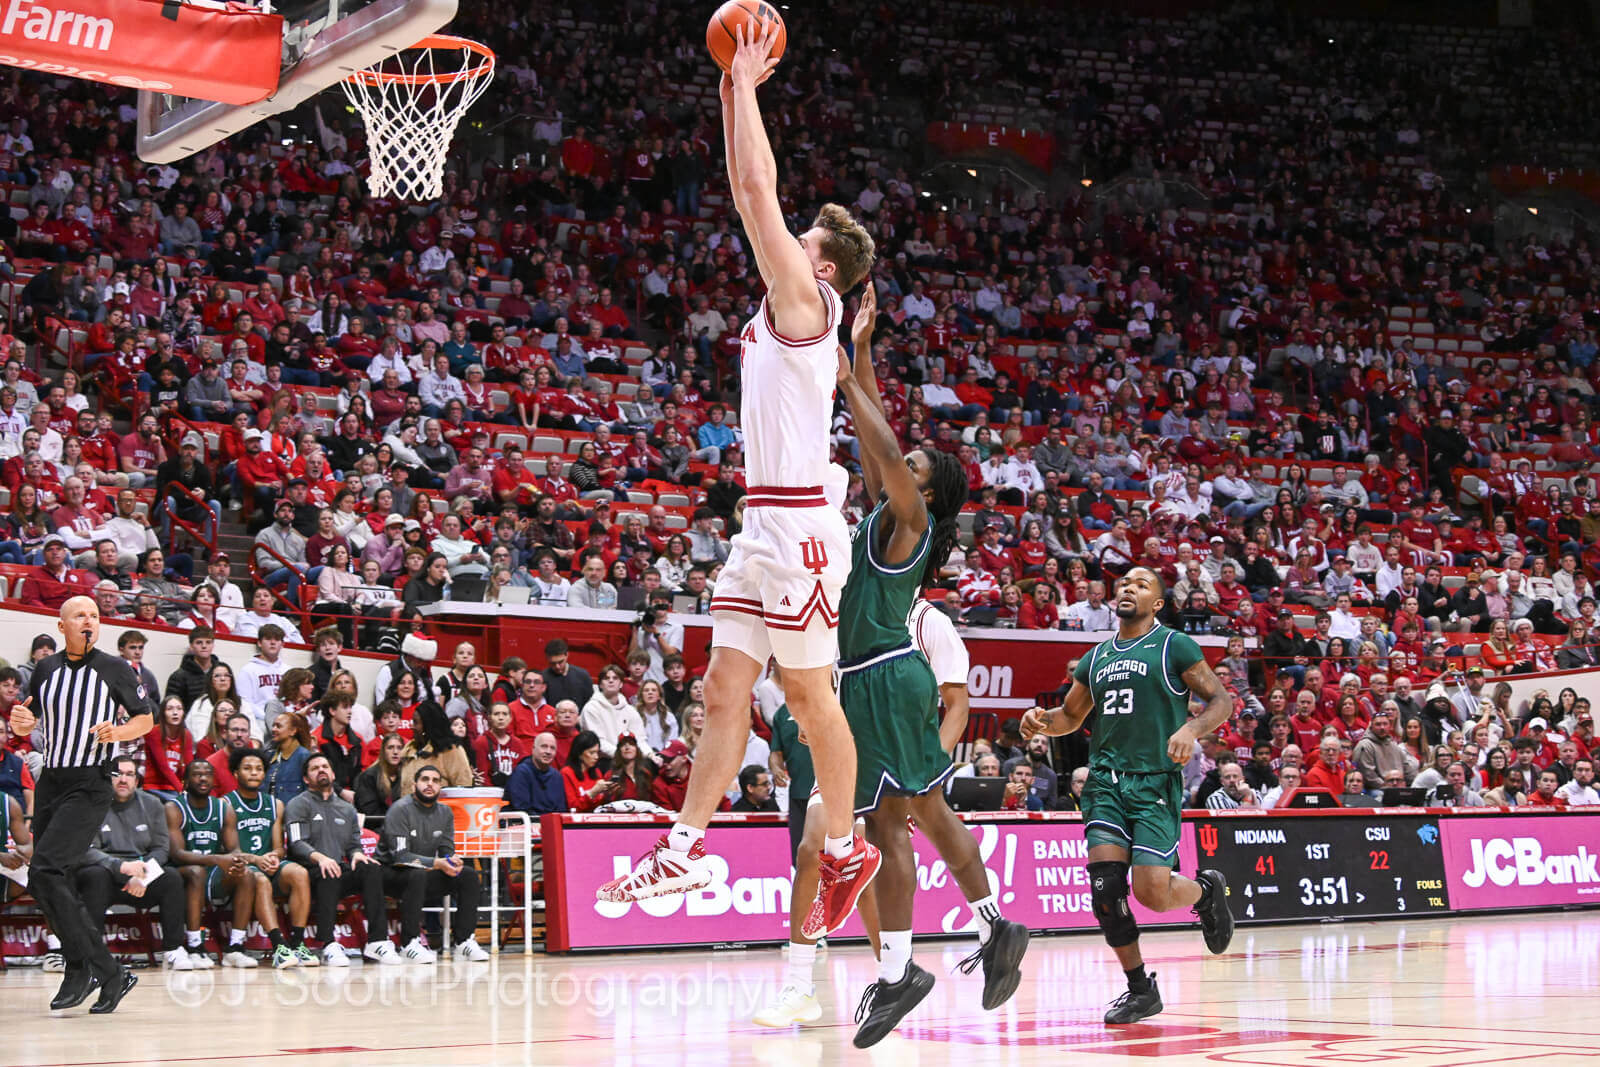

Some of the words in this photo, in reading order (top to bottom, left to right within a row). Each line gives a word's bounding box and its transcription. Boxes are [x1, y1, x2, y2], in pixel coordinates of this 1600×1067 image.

[1, 0, 114, 51] Farm
[988, 132, 998, 146] E
[1096, 659, 1148, 684] CHICAGO
[1108, 672, 1130, 682] STATE
[1103, 688, 1134, 715] 23
[478, 807, 493, 826] G
[1234, 830, 1286, 844] INDIANA
[1365, 827, 1390, 841] CSU
[250, 835, 262, 851] 3
[1305, 844, 1330, 859] 1ST
[1255, 855, 1275, 875] 41
[1369, 850, 1390, 870] 22
[1462, 837, 1600, 888] JCBank
[1244, 884, 1253, 898] 4
[1299, 876, 1349, 906] 3:51
[1394, 877, 1402, 891] 7
[1416, 880, 1442, 890] FOULS
[1038, 892, 1094, 913] TRUS
[1397, 897, 1406, 911] 3
[1429, 897, 1444, 907] TOL
[1246, 904, 1255, 918] 4
